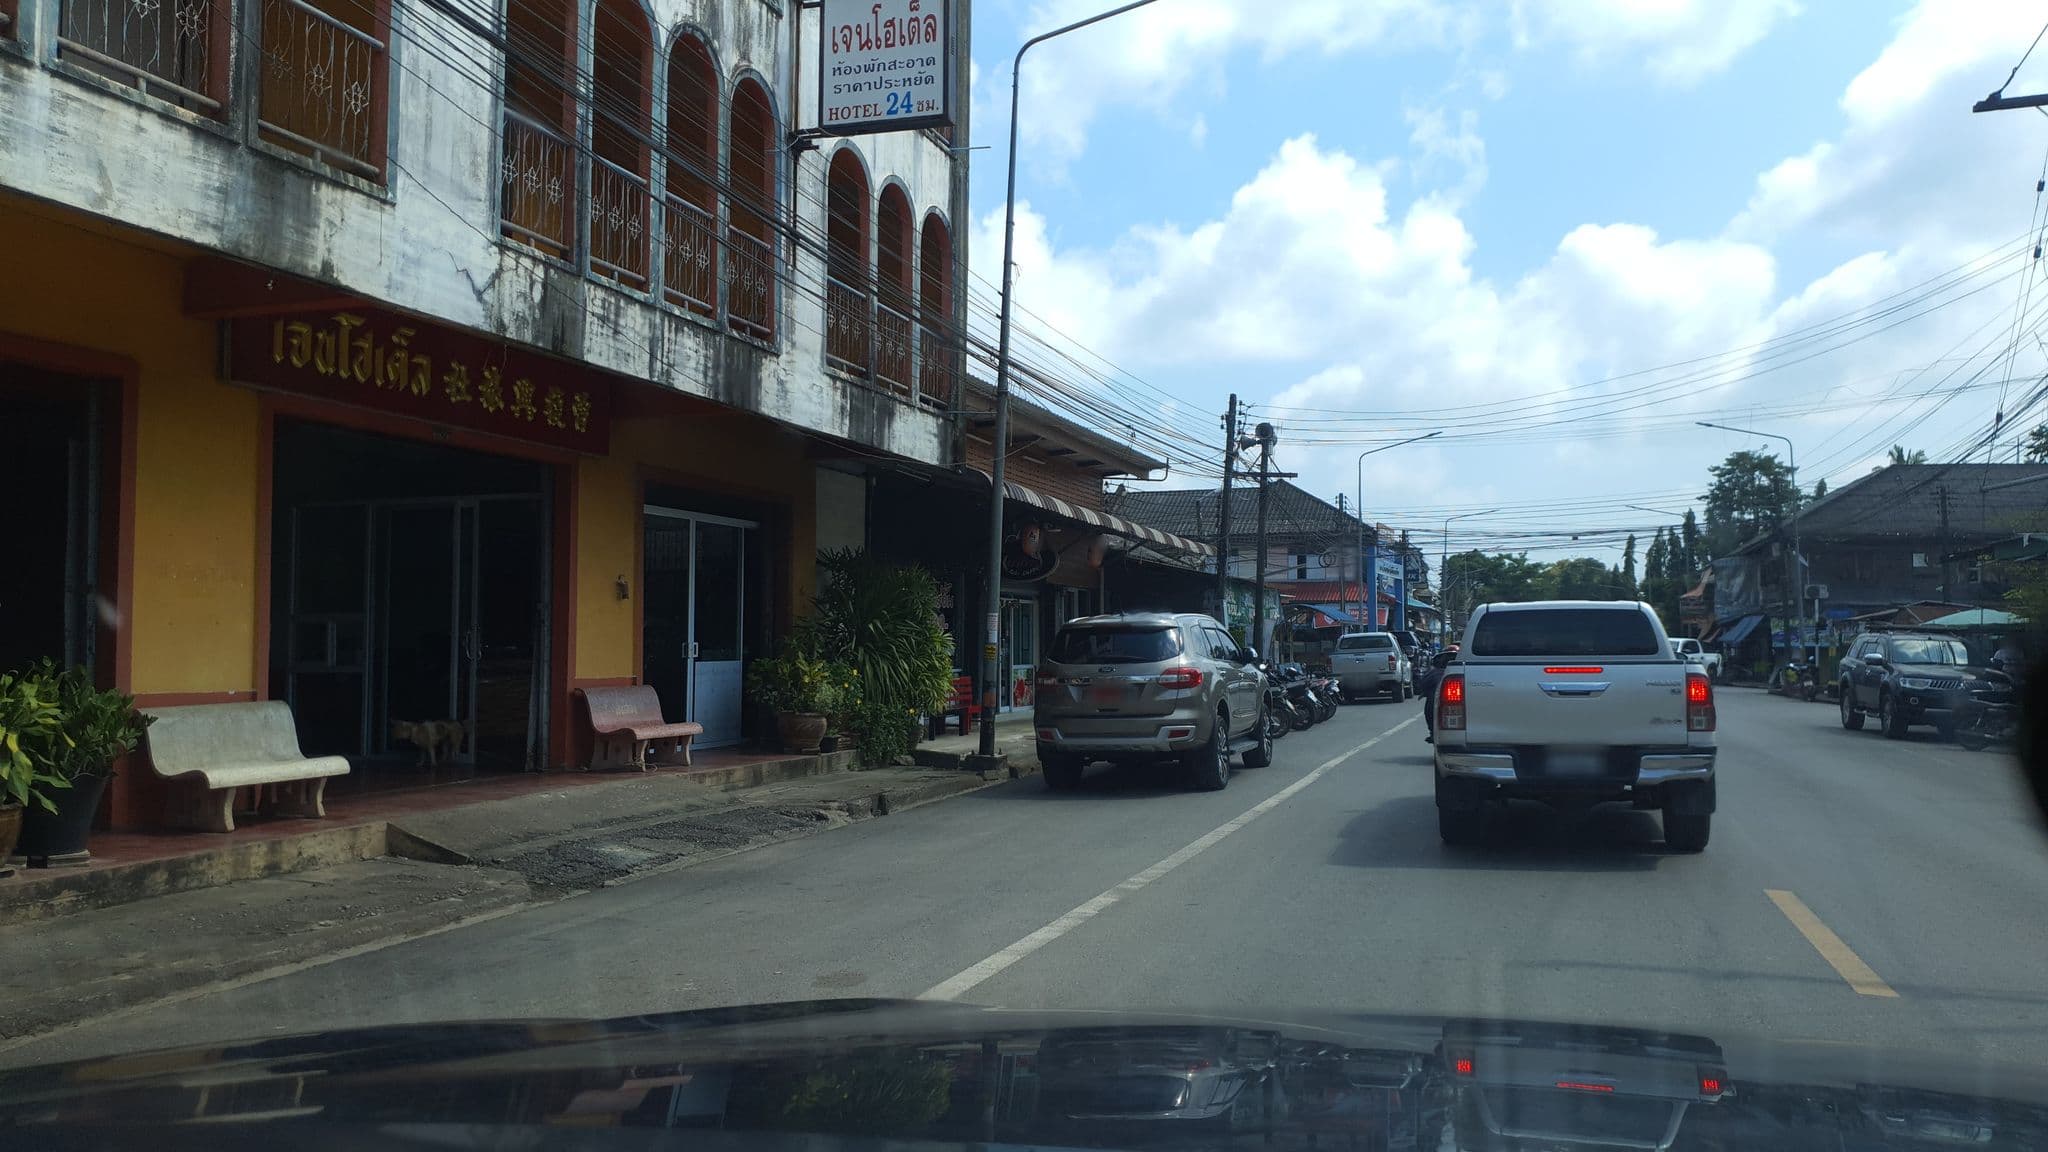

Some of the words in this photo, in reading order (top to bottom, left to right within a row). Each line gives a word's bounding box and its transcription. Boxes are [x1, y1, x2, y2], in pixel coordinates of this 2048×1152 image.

[832, 56, 936, 76] ห้องพักสะอาด
[834, 71, 935, 94] ราคาประหยัด
[829, 103, 882, 121] HOTEL
[886, 91, 913, 116] 24
[916, 99, 939, 112] ชม.
[272, 313, 433, 396] เจนโฮเต็ล
